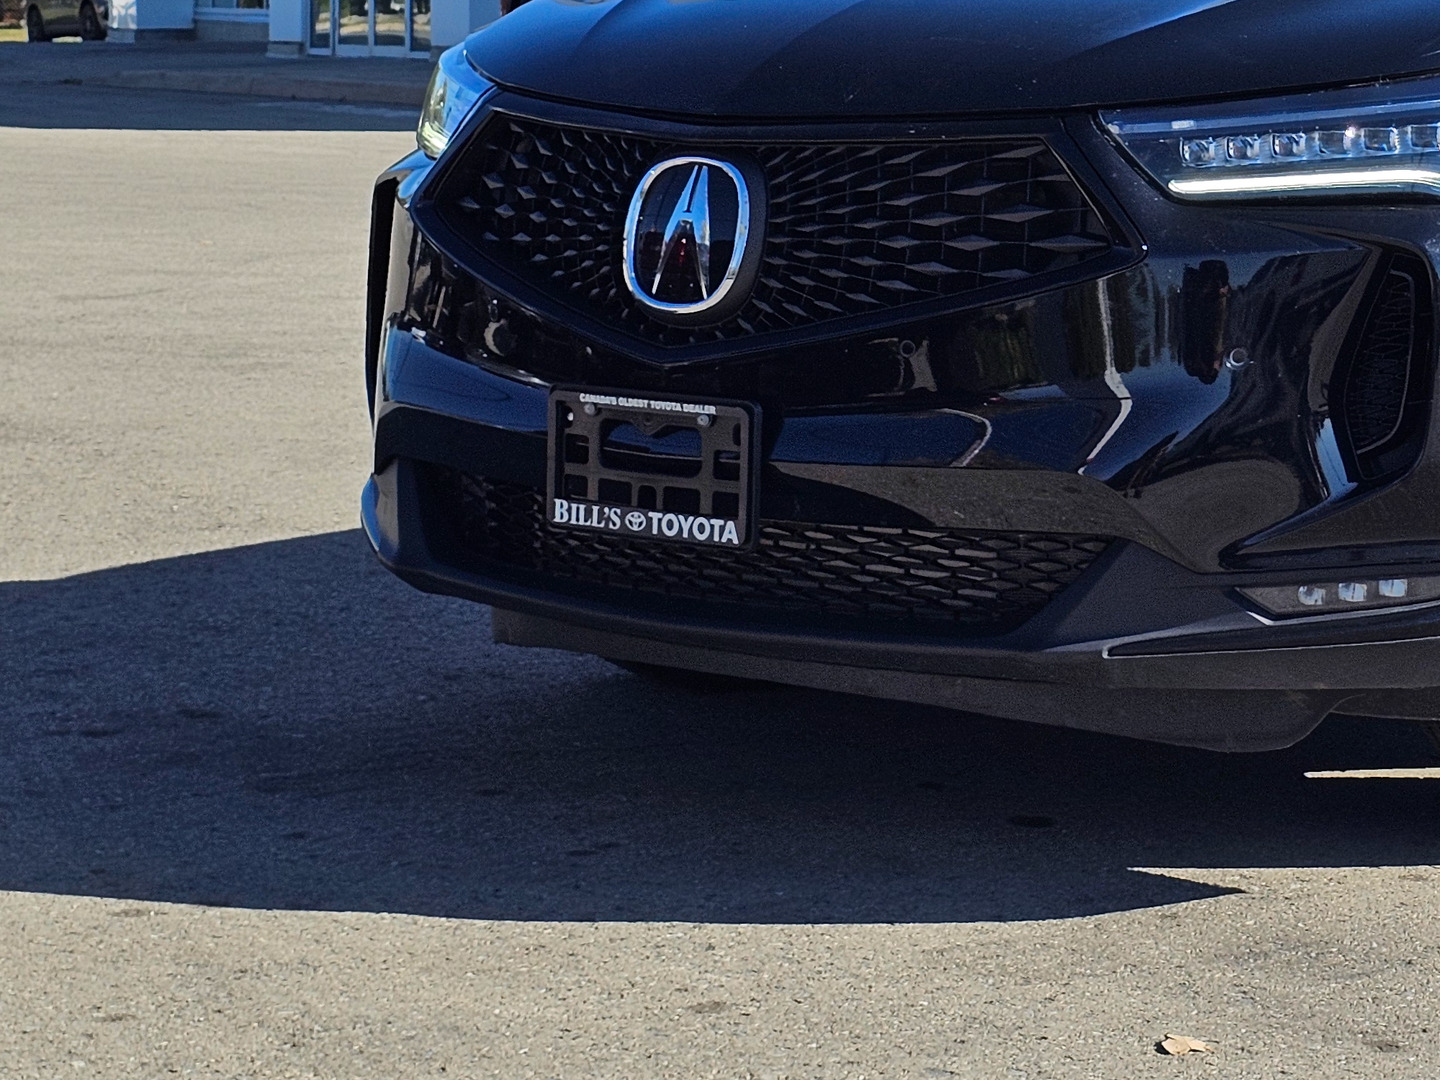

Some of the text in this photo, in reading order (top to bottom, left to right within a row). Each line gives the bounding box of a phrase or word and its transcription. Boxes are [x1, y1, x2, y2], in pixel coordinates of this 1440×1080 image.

[579, 393, 717, 415] CANADA'S OLDEST TOYOTA DEALER
[553, 498, 739, 545] BILL'S TOYOTA
